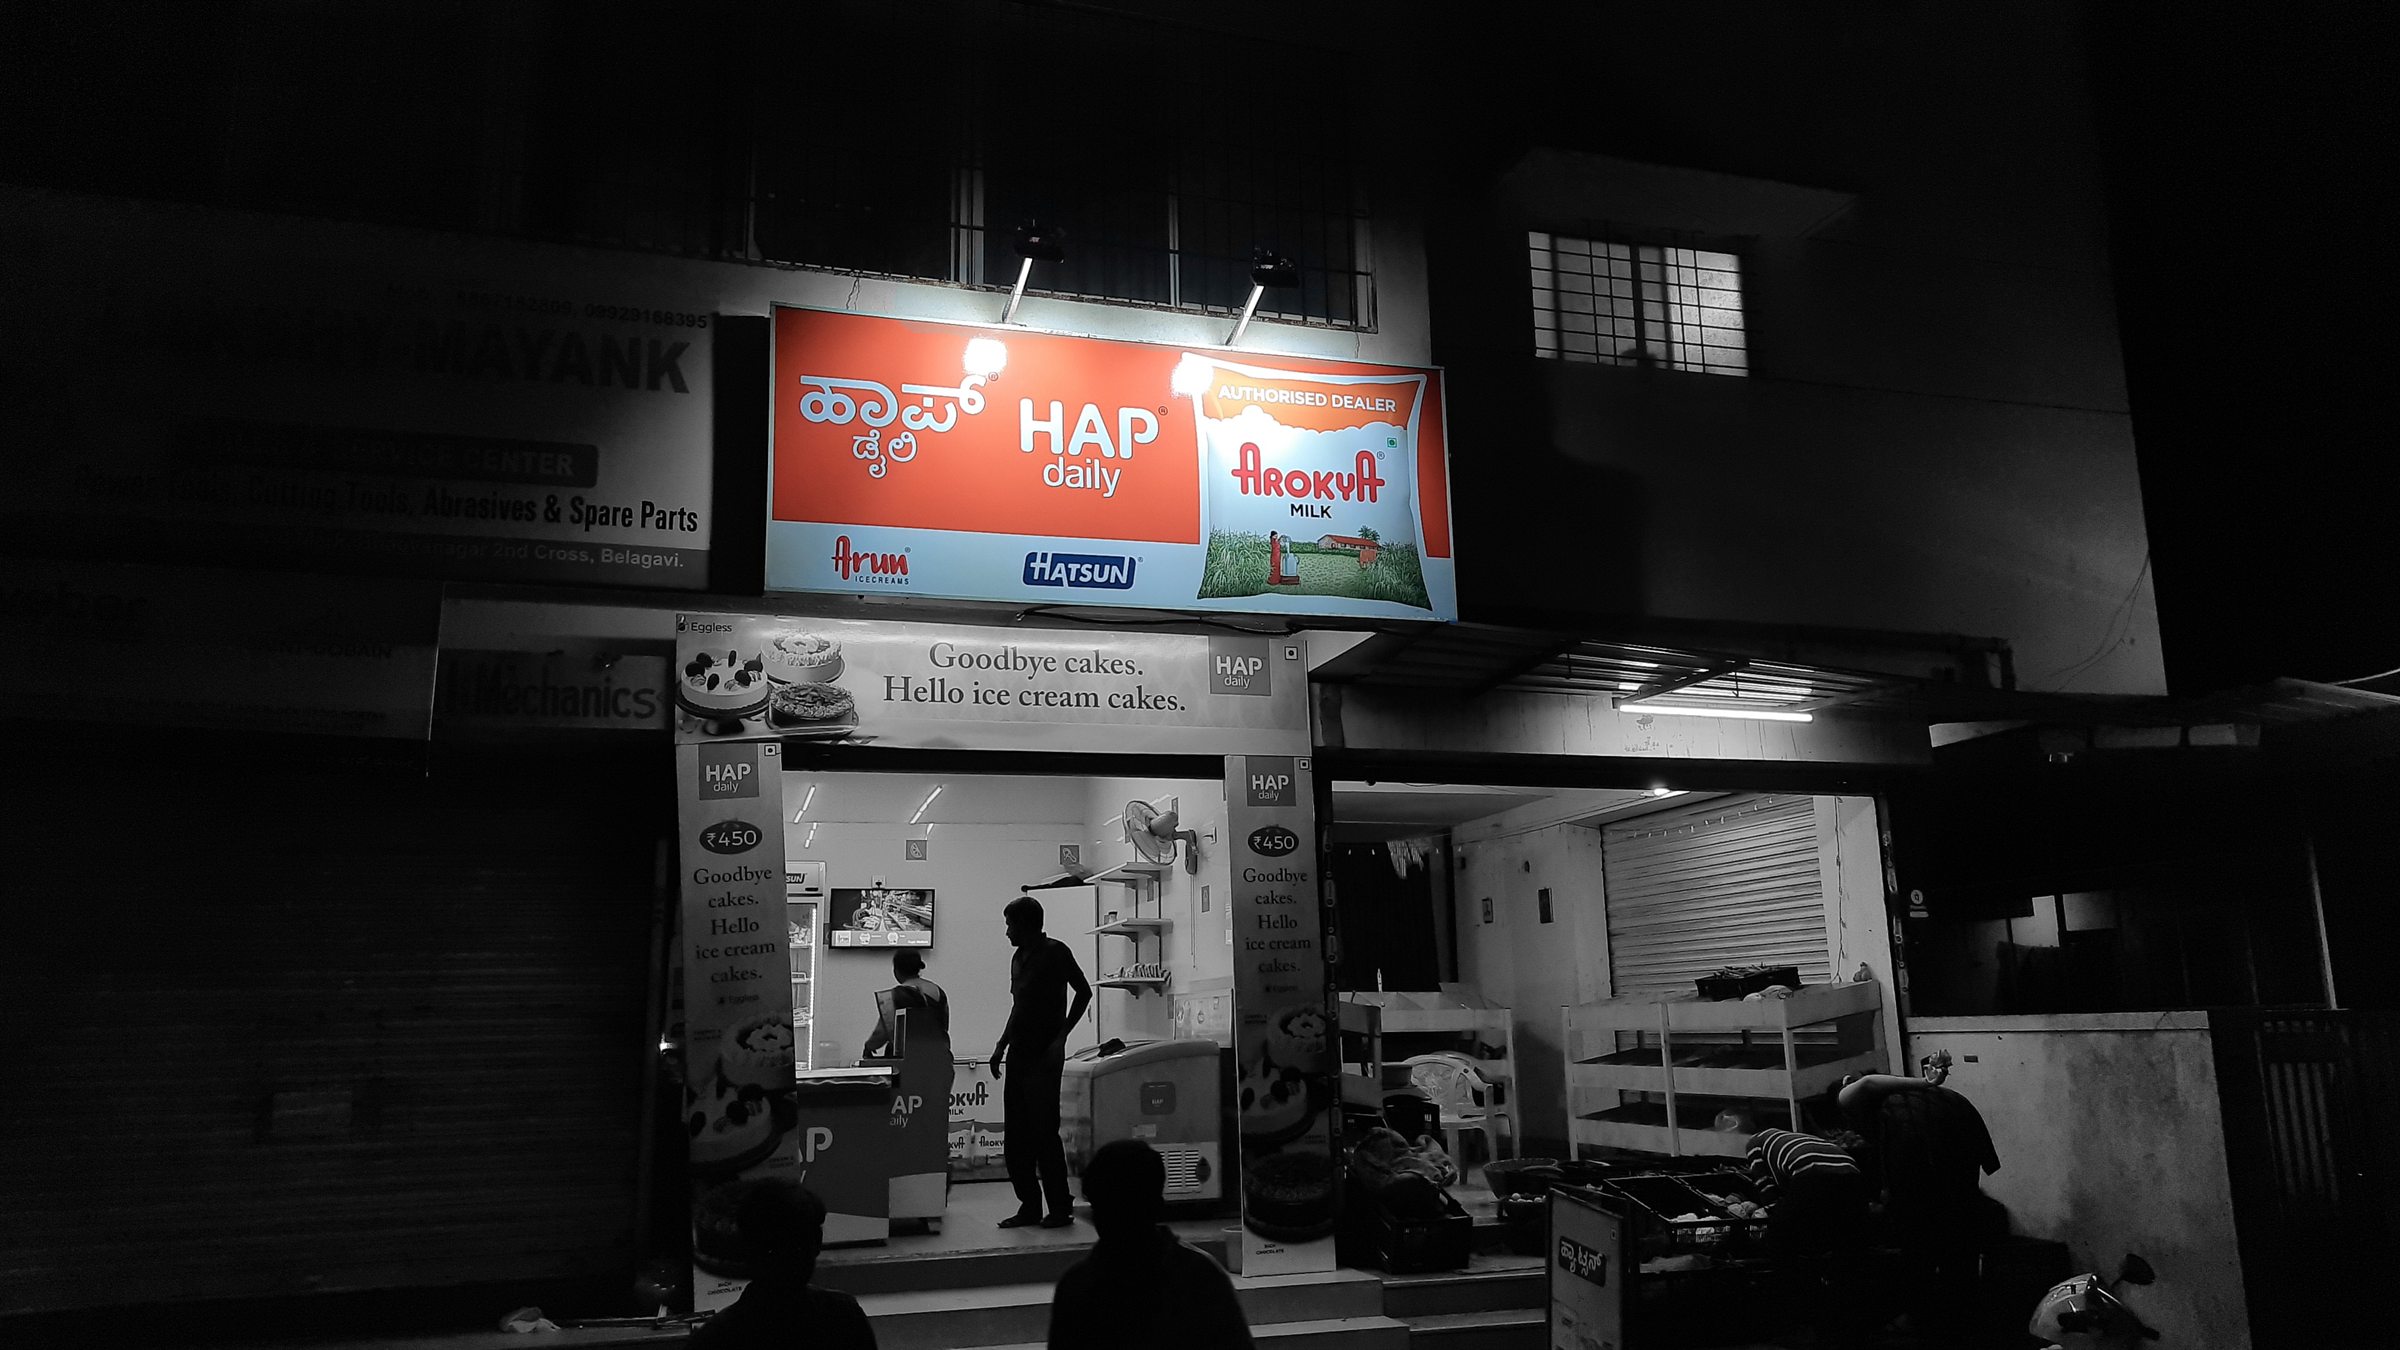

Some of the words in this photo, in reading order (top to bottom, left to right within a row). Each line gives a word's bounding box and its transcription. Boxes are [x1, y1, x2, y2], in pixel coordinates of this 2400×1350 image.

[1218, 385, 1328, 407] AUTHORISED
[1331, 394, 1397, 413] DEALER
[1019, 396, 1160, 460] HAP
[462, 445, 575, 477] CENTER
[1042, 455, 1122, 499] daily
[422, 487, 537, 523] Abrasives
[543, 494, 562, 523] &
[569, 495, 634, 532] Spare
[640, 500, 699, 532] Parts
[1290, 503, 1333, 519] MILK
[492, 541, 530, 560] 2nd
[534, 544, 596, 565] Cross,
[601, 547, 685, 569] Belagavi.
[832, 535, 909, 581] Arun
[1029, 552, 1132, 586] HATSUN
[855, 575, 910, 586] ICECREAMS
[691, 622, 733, 634] Eggless
[929, 641, 1058, 680] Goodbye
[1065, 649, 1145, 676] cakes.
[1215, 655, 1264, 678] HAP
[1223, 674, 1251, 690] daily
[882, 675, 965, 704] Hello
[973, 681, 1012, 706] ice
[1018, 687, 1101, 709] cream
[1107, 684, 1187, 712] cakes.
[704, 763, 752, 783] HAP
[1251, 774, 1290, 791] HAP
[713, 780, 740, 794] daily
[1258, 789, 1281, 802] daily
[706, 829, 758, 848] ₹450
[1252, 835, 1296, 851] ₹450
[693, 866, 773, 887] Goodbye
[1243, 867, 1308, 887] Goodbye
[708, 892, 760, 910] cakes.
[1255, 889, 1298, 906] cakes.
[710, 917, 760, 936] Hello
[1258, 914, 1299, 931] Hello
[696, 944, 720, 960] ice
[724, 941, 777, 957] cream
[1245, 937, 1265, 952] ice
[1268, 935, 1312, 951] cream
[1257, 956, 1302, 974] cakes.
[710, 967, 763, 984] cakes.
[890, 1095, 923, 1115] AP
[888, 1115, 909, 1129] aily
